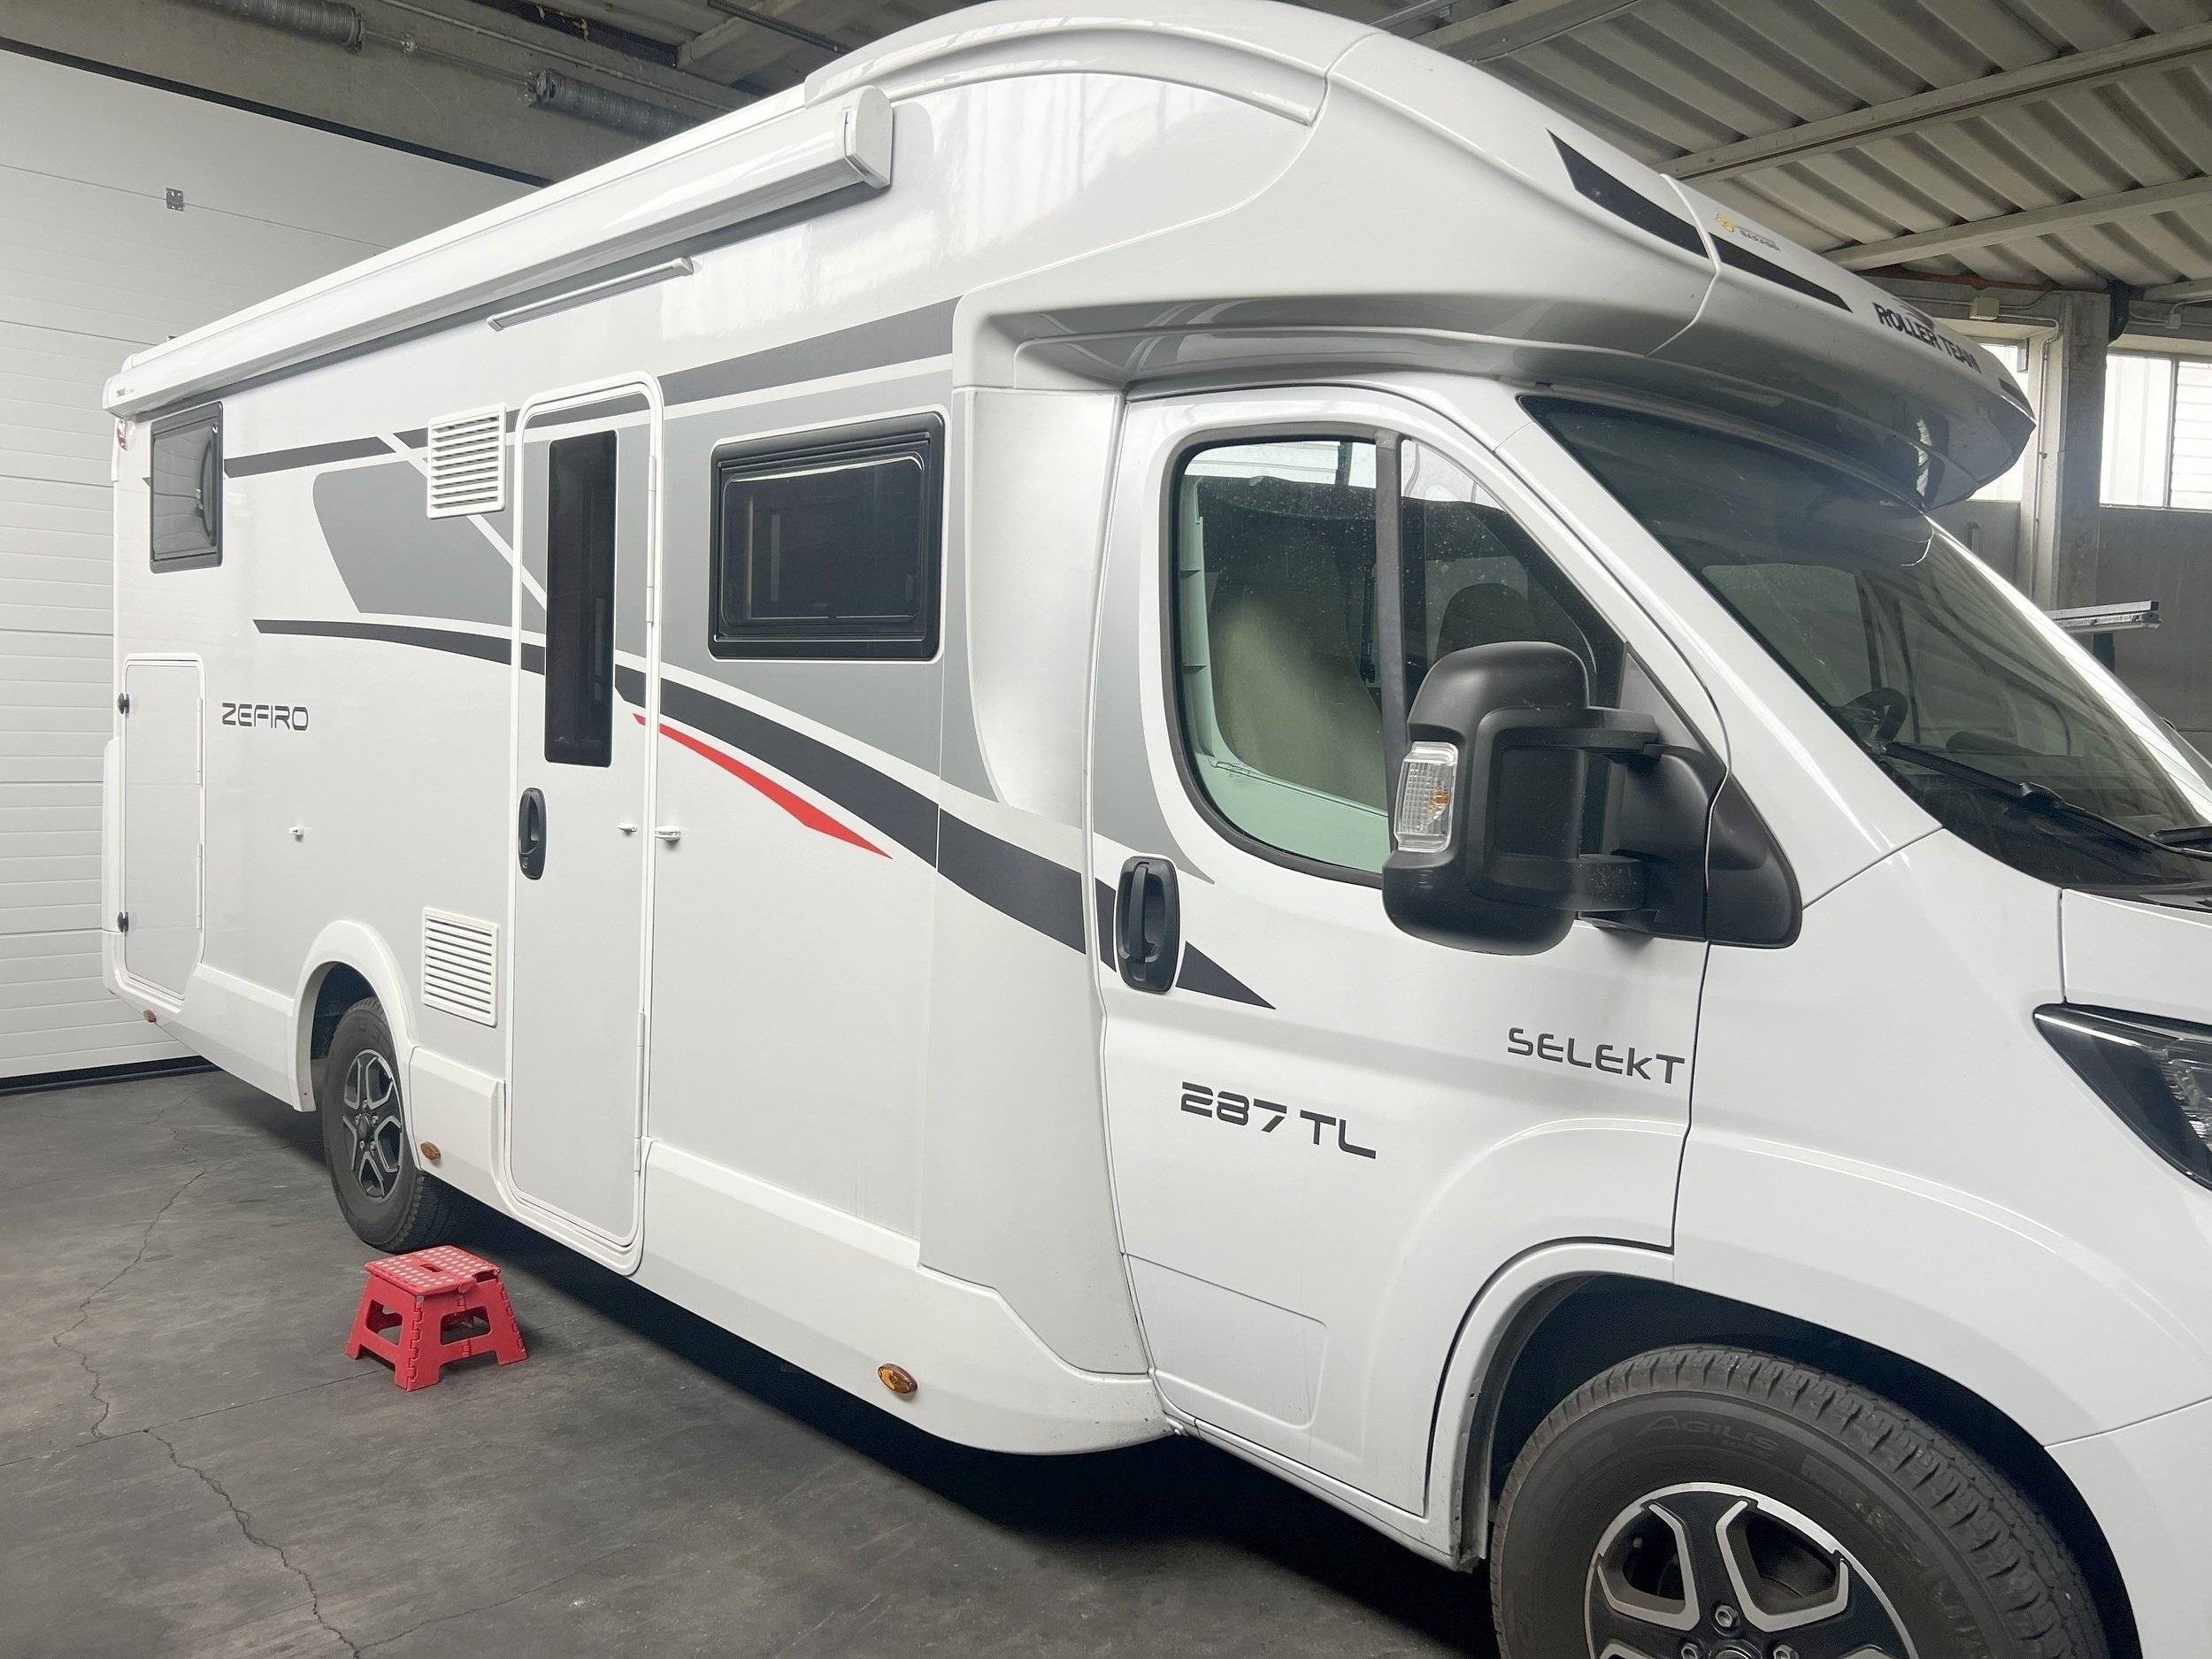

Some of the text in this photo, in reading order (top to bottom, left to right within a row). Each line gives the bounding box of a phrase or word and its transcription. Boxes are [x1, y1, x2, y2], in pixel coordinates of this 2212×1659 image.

[1872, 302, 1982, 374] ROLLER TEAM
[222, 703, 309, 731] ZEFIRO
[1180, 1081, 1377, 1159] 287 TL
